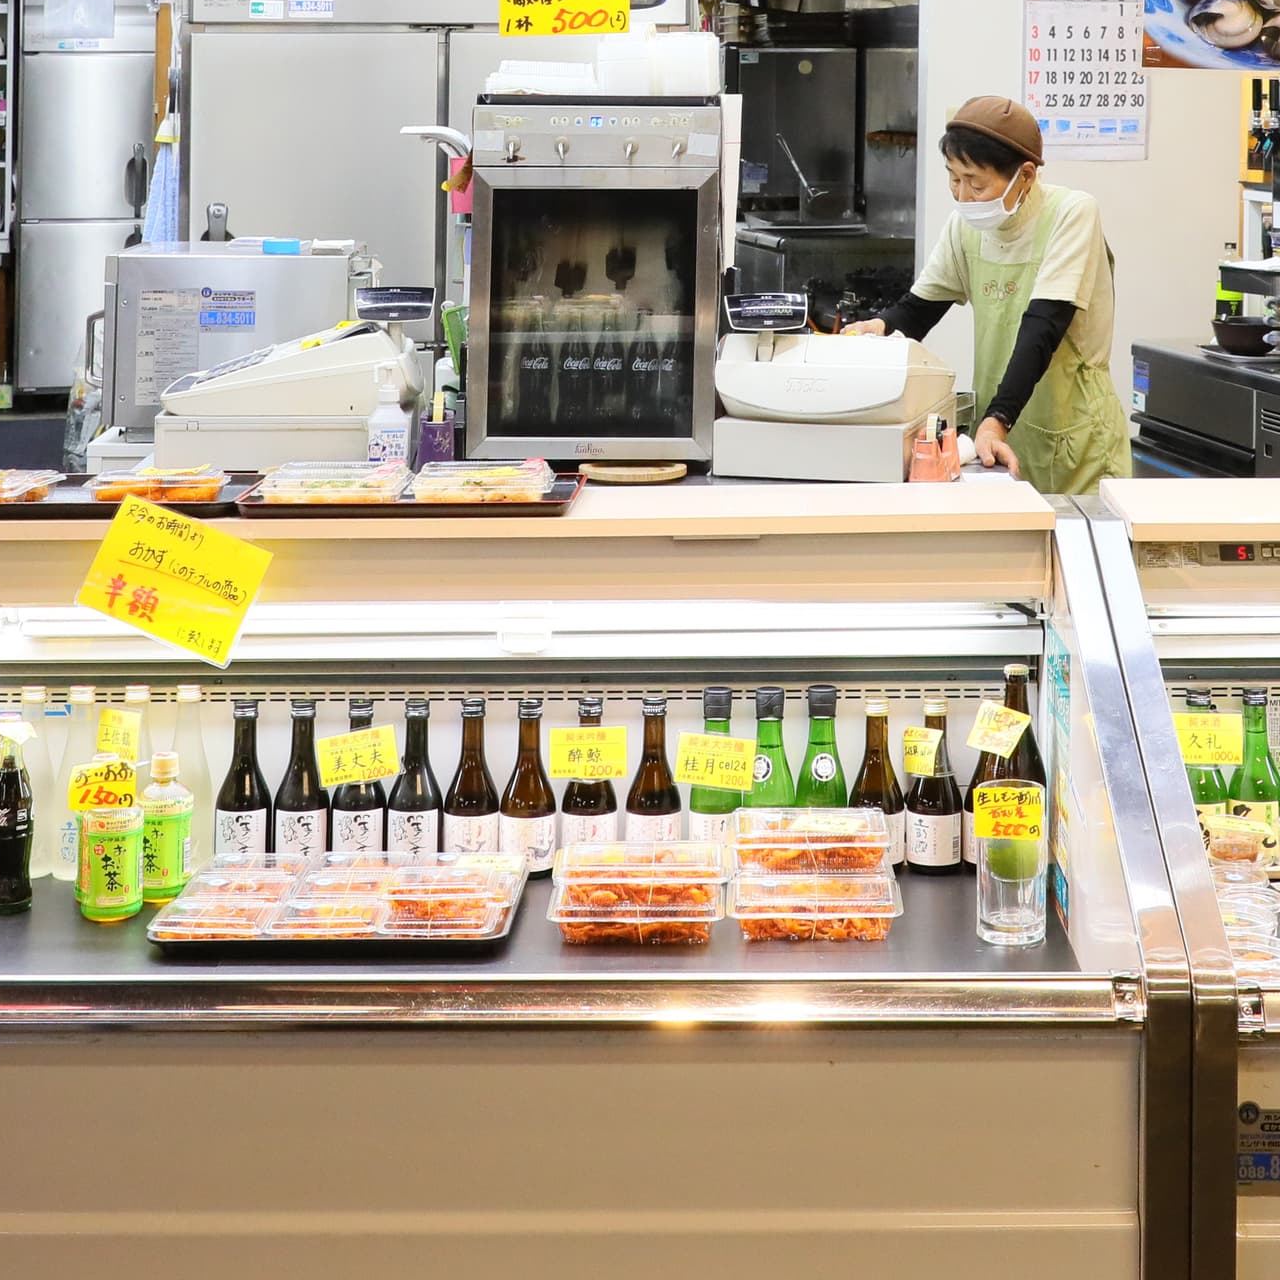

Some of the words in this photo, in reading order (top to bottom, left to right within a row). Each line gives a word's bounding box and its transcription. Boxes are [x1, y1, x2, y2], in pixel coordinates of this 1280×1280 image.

[1028, 72, 1040, 84] 17
[1046, 72, 1057, 84] 18
[1063, 72, 1075, 84] 19
[1080, 72, 1093, 84] 20
[1098, 72, 1109, 84] 21
[1114, 72, 1127, 84] 22
[105, 573, 160, 624] 半額
[1187, 733, 1222, 751] 久礼
[333, 748, 384, 773] 美丈夫
[567, 748, 603, 763] 酔鯨
[683, 754, 714, 773] 桂月
[718, 760, 747, 772] cel24
